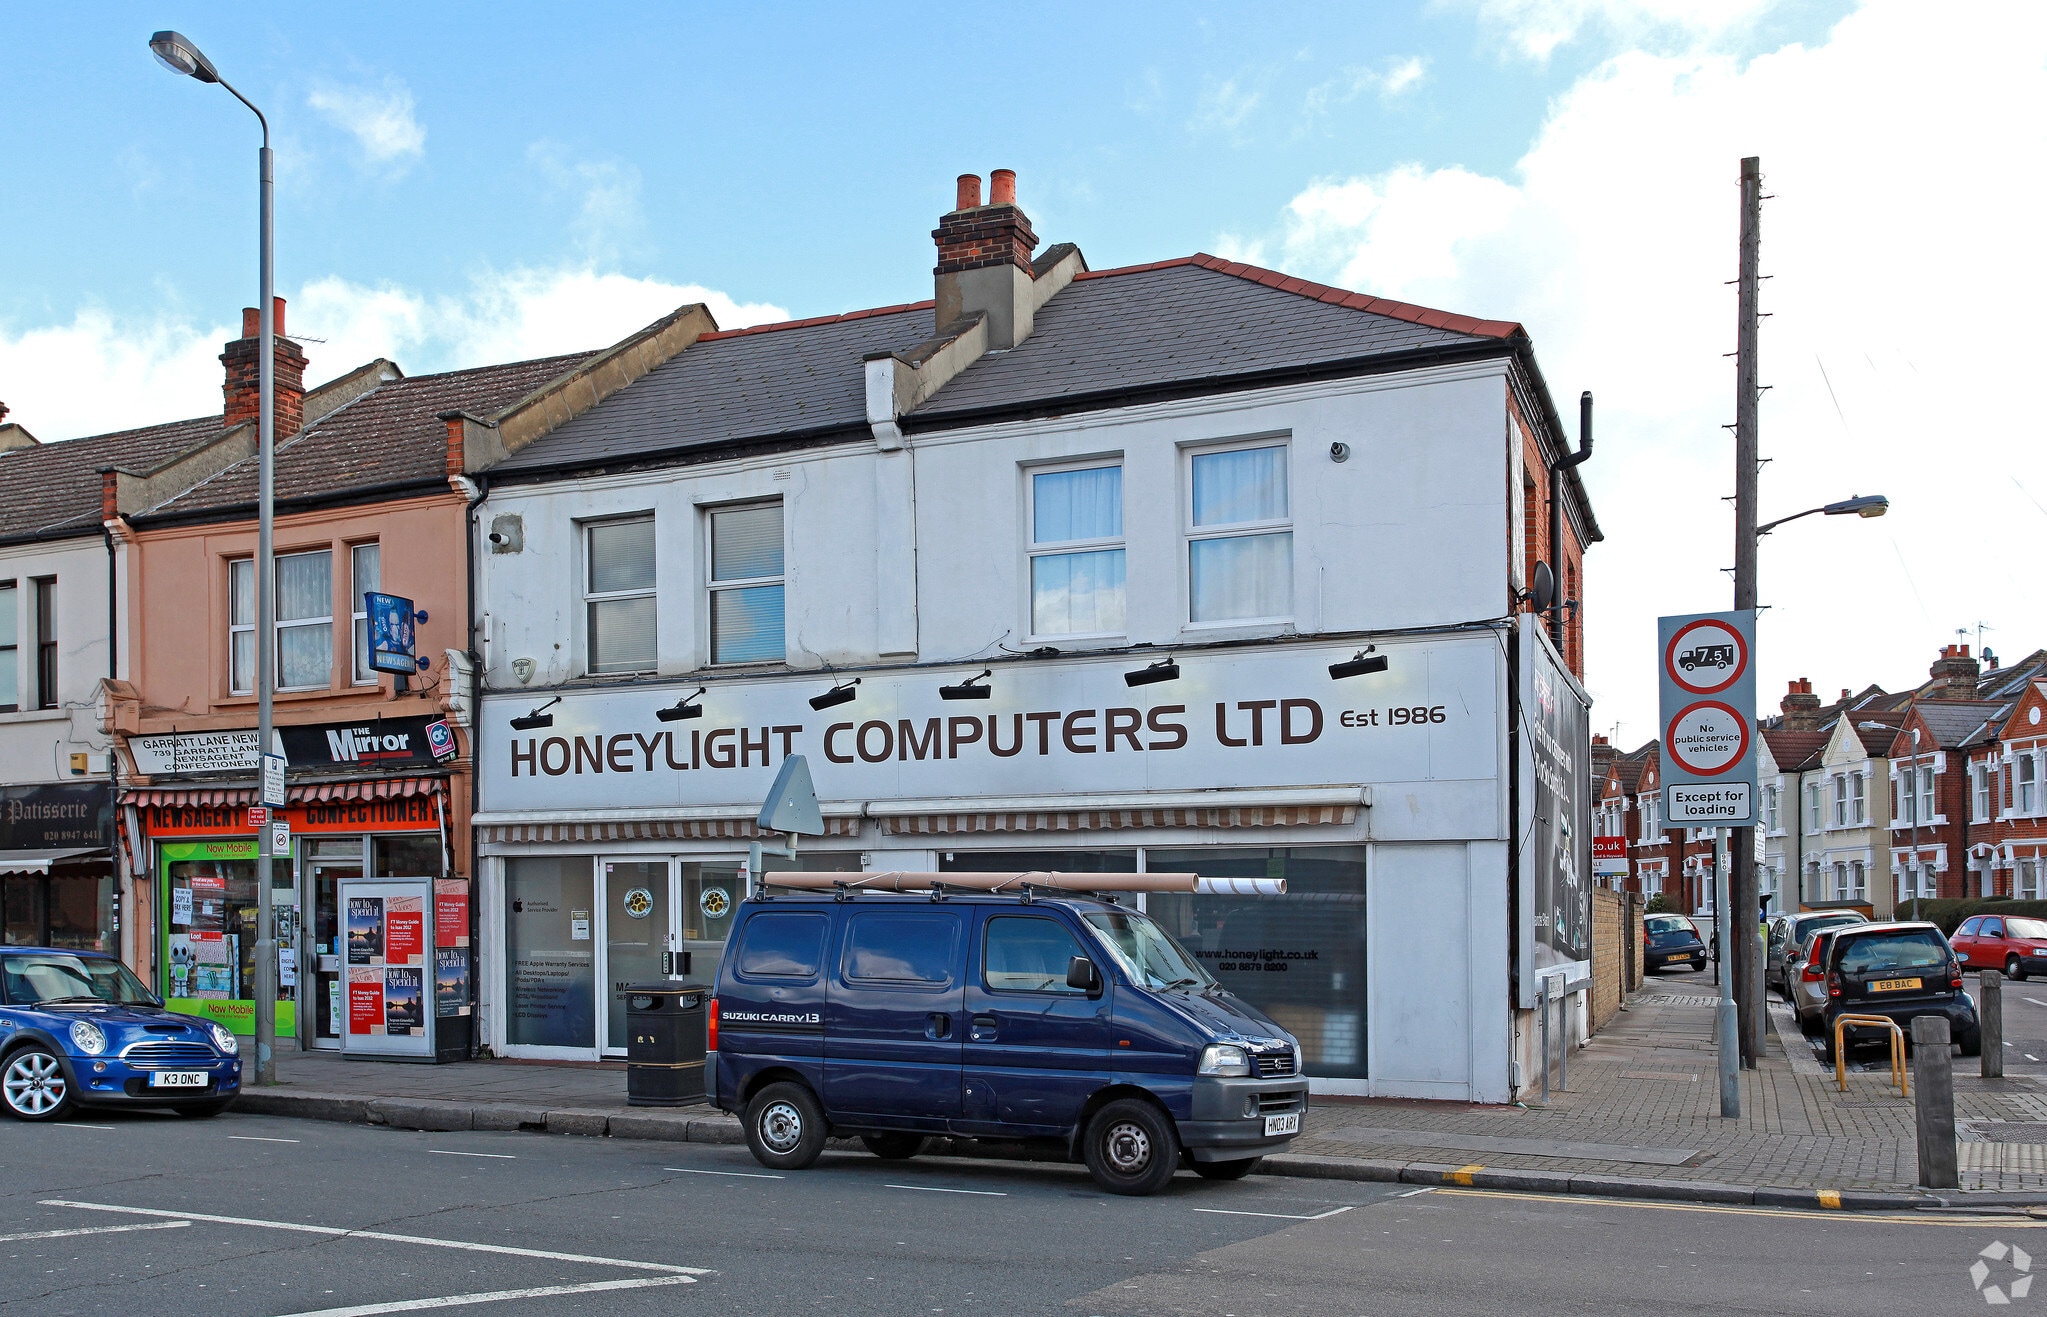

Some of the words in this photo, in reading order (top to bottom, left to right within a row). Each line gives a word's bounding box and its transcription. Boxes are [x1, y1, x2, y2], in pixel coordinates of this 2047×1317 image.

[376, 596, 391, 604] NEW
[376, 655, 415, 669] NEWSAGENTS
[353, 727, 370, 735] THE
[1699, 725, 1714, 733] No
[143, 738, 195, 749] GARRATT
[198, 735, 230, 746] LANE
[233, 734, 259, 744] NEW
[510, 724, 803, 778] HONEYLIGHT
[823, 703, 1188, 764] COMPUTERS
[1215, 698, 1324, 747] LTD
[1339, 709, 1379, 727] Est
[1387, 705, 1446, 726] 1986
[1675, 735, 1704, 745] public
[1706, 734, 1740, 742] service
[326, 729, 409, 762] Mirror
[1688, 744, 1729, 752] vehicles
[174, 747, 227, 756] GARRATT
[174, 753, 244, 763] NEWSAGENT
[164, 759, 259, 771] CONFECTIONERY
[1675, 792, 1721, 803] Except
[1724, 791, 1744, 801] for
[7, 799, 88, 824] Patisserie
[1685, 804, 1736, 816] loading
[153, 808, 240, 828] NEWSAGENT
[44, 831, 59, 840] 020
[61, 831, 80, 840] 8947
[206, 844, 224, 853] Now
[226, 843, 252, 852] Mobile
[1593, 841, 1620, 850] co.uk
[182, 904, 192, 912] HERE
[362, 899, 370, 909] to
[394, 904, 413, 912] Money
[351, 905, 373, 919] spend
[374, 905, 379, 917] it
[436, 950, 451, 960] how
[1195, 949, 1319, 961] www.honeylight.co.uk
[440, 956, 461, 970] spend
[1219, 962, 1236, 971] 020
[401, 969, 409, 979] to
[389, 976, 411, 989] spend
[412, 976, 418, 986] it
[1880, 982, 1892, 990] E8
[1895, 980, 1913, 989] BAC
[208, 1004, 226, 1013] Now
[228, 1004, 254, 1014] Mobile
[722, 1012, 760, 1021] SUZUKI
[761, 1014, 804, 1022] CARRY
[806, 1013, 820, 1023] 1.3
[164, 1074, 178, 1084] K3
[1268, 1117, 1284, 1133] HN03
[1285, 1116, 1297, 1131] ARX
